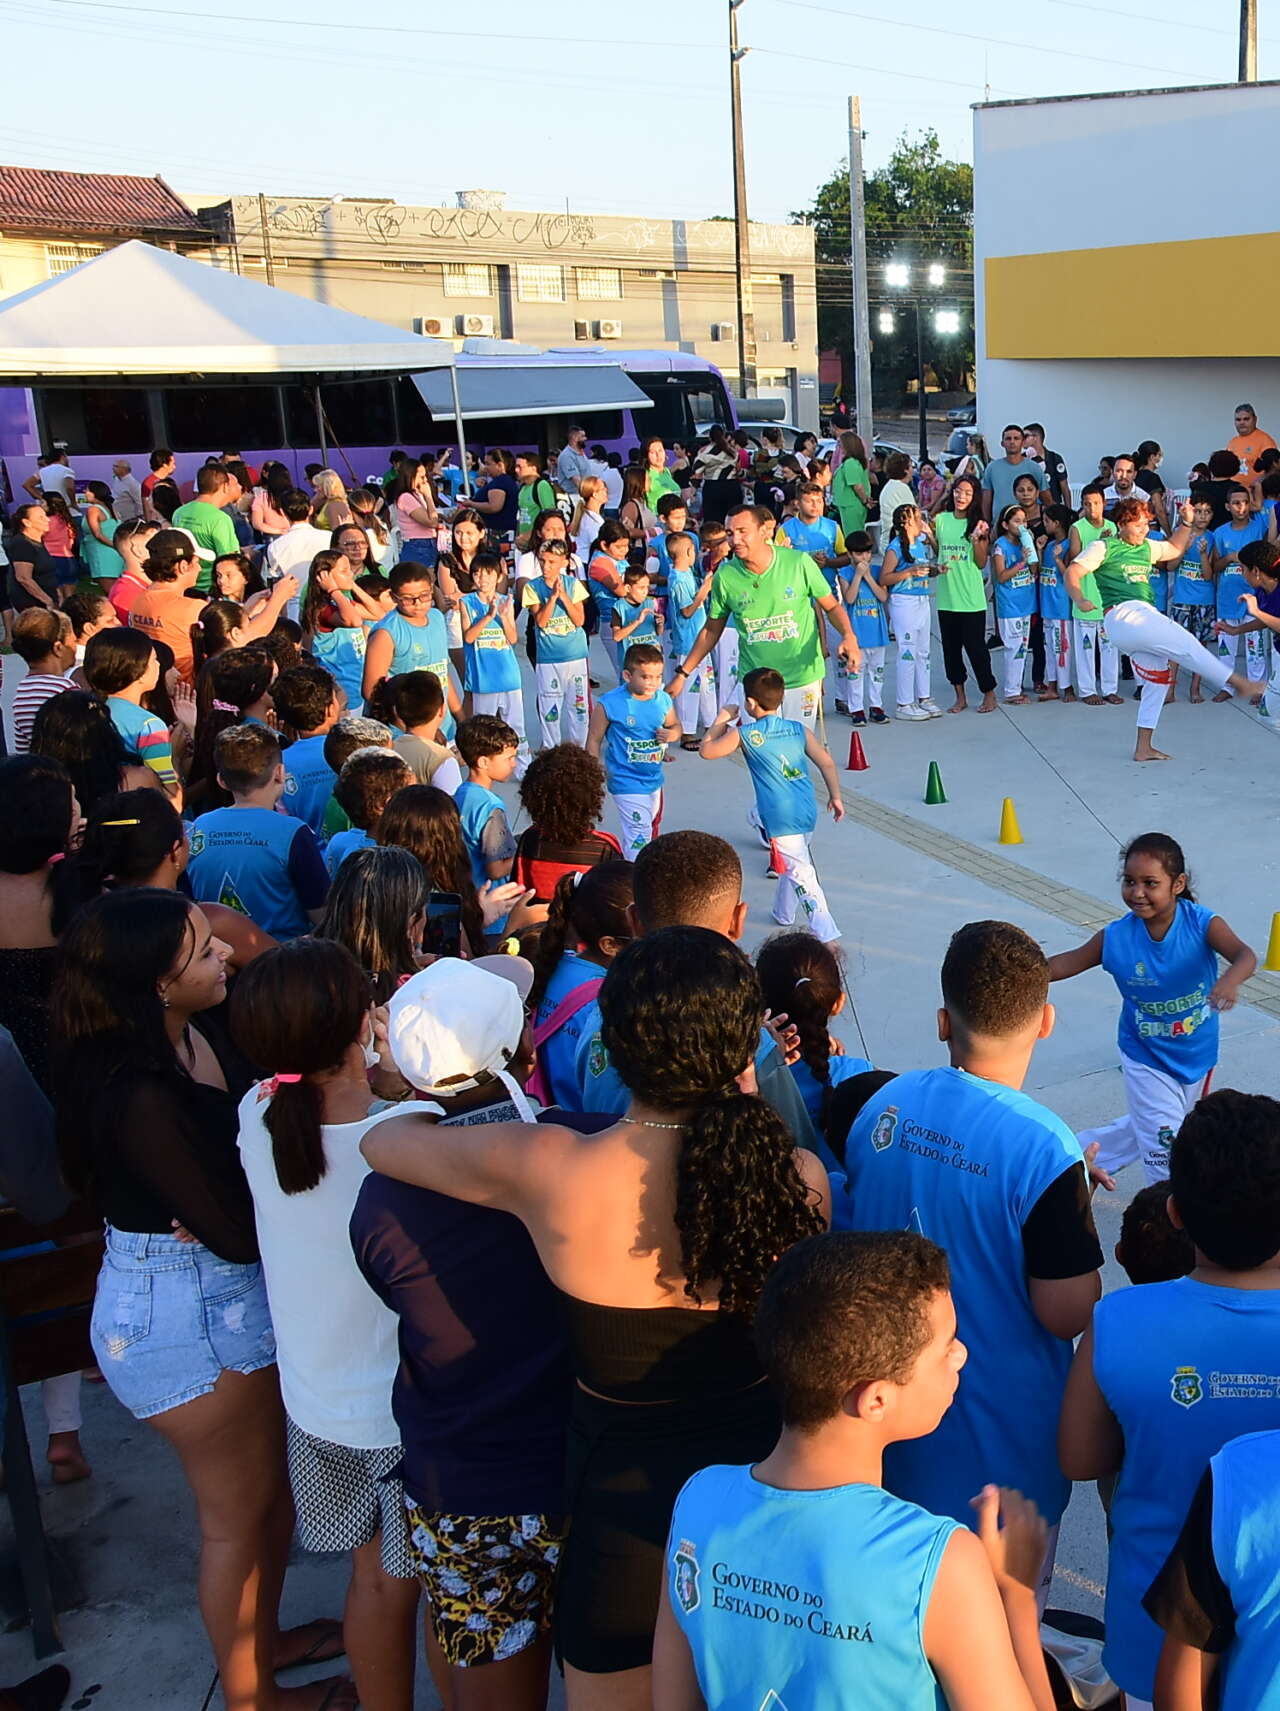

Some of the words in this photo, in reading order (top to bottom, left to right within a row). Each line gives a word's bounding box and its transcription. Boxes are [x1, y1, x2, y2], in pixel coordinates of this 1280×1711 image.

[1139, 990, 1205, 1016] ESPORTE
[902, 1118, 951, 1147] GOVERNO
[899, 1133, 939, 1160] ESTADO
[952, 1152, 990, 1177] CEARÁ
[1208, 1371, 1268, 1385] GOVERNO
[712, 1562, 799, 1602] GOVERNO
[803, 1591, 824, 1608] DO
[712, 1587, 779, 1623] ESTADO
[784, 1613, 803, 1629] DO
[808, 1610, 873, 1642] CEARÁ
